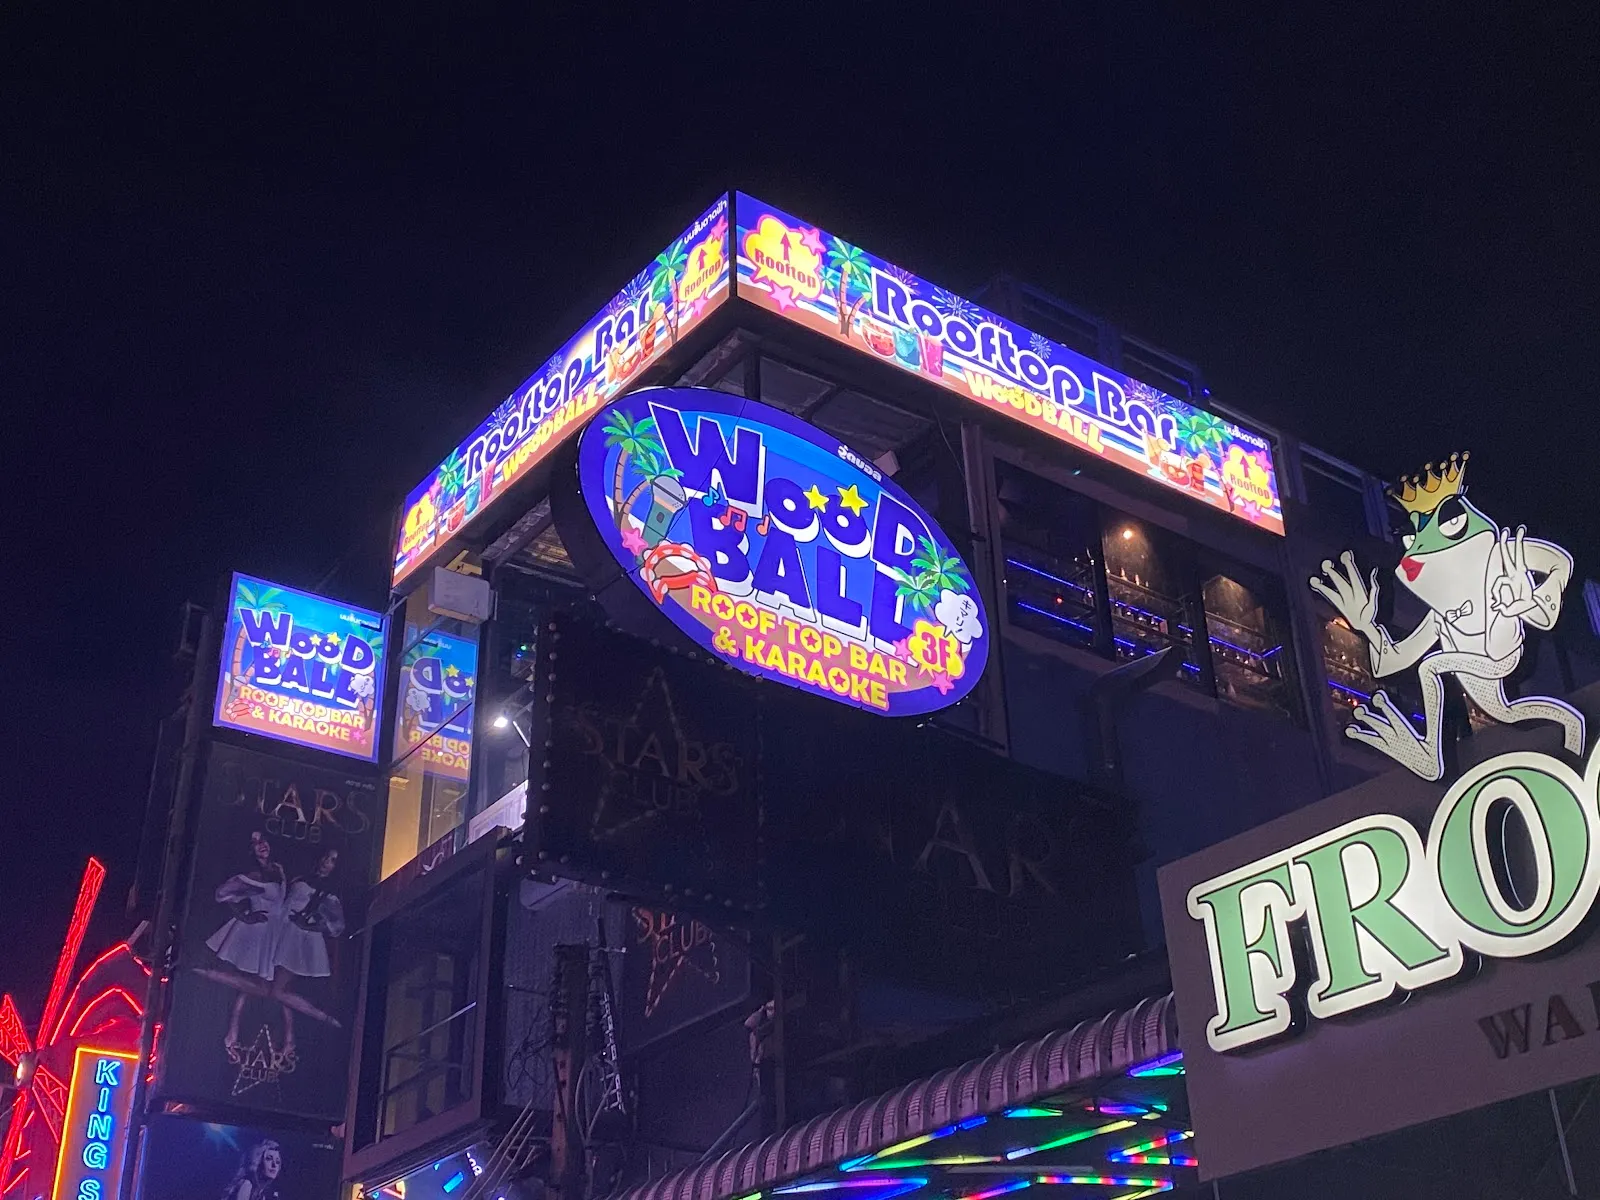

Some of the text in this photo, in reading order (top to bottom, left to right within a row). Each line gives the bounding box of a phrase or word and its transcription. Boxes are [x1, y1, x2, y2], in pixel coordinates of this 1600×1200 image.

[684, 258, 721, 298] Rooftop
[754, 247, 817, 291] Rooftop
[871, 266, 1179, 450] Rooftop Bar
[463, 286, 652, 488] Rooftop Bar
[1229, 473, 1270, 500] Rooftop
[688, 497, 920, 667] BALL
[691, 585, 907, 686] ROOF TOP BAR
[921, 631, 950, 669] 3F
[254, 645, 359, 708] BALL
[714, 626, 888, 709] & KARAOKE
[251, 705, 352, 742] & KARAOKE
[330, 711, 366, 729] BAR
[264, 816, 322, 844] CLUB
[1187, 736, 1600, 1052] FRO
